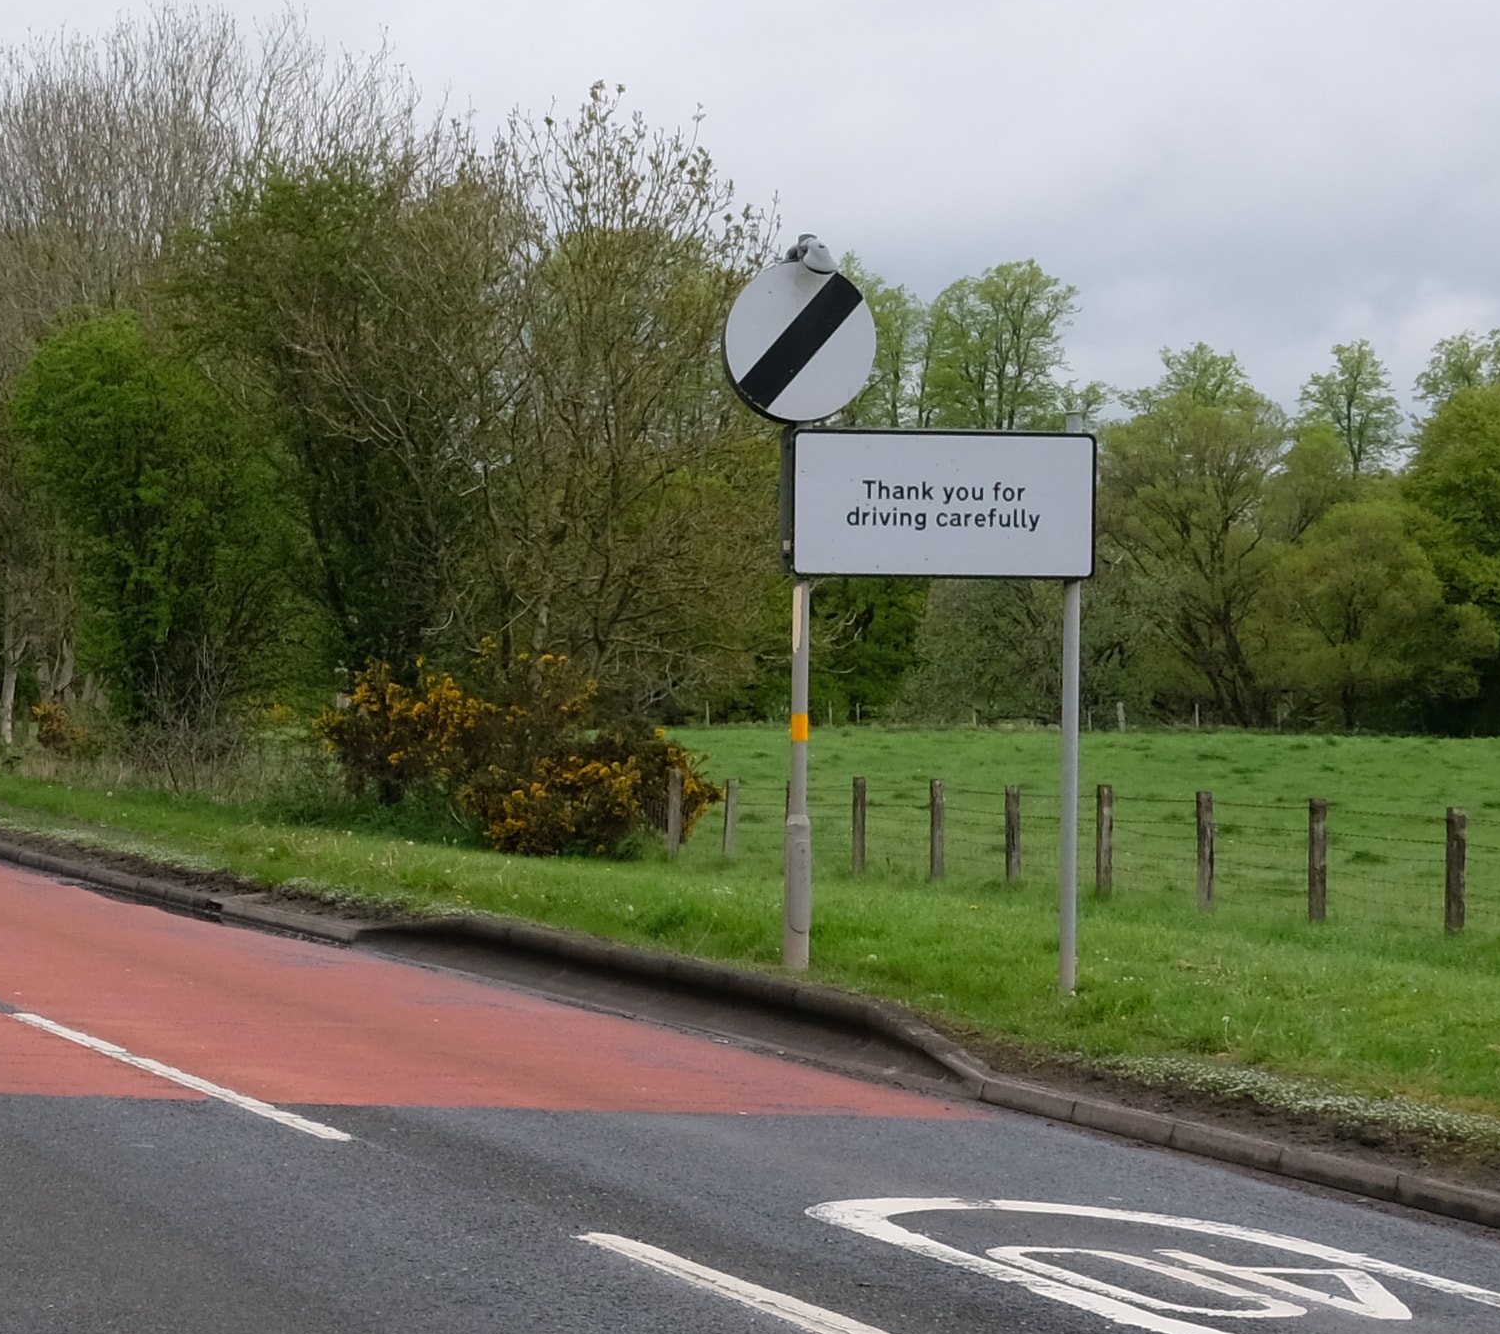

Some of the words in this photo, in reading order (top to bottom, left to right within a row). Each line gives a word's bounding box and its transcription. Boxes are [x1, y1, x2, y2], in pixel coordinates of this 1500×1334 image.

[862, 480, 934, 501] Thank
[943, 486, 984, 504] you
[992, 482, 1026, 502] for
[846, 506, 927, 531] driving
[935, 509, 1041, 533] carefully
